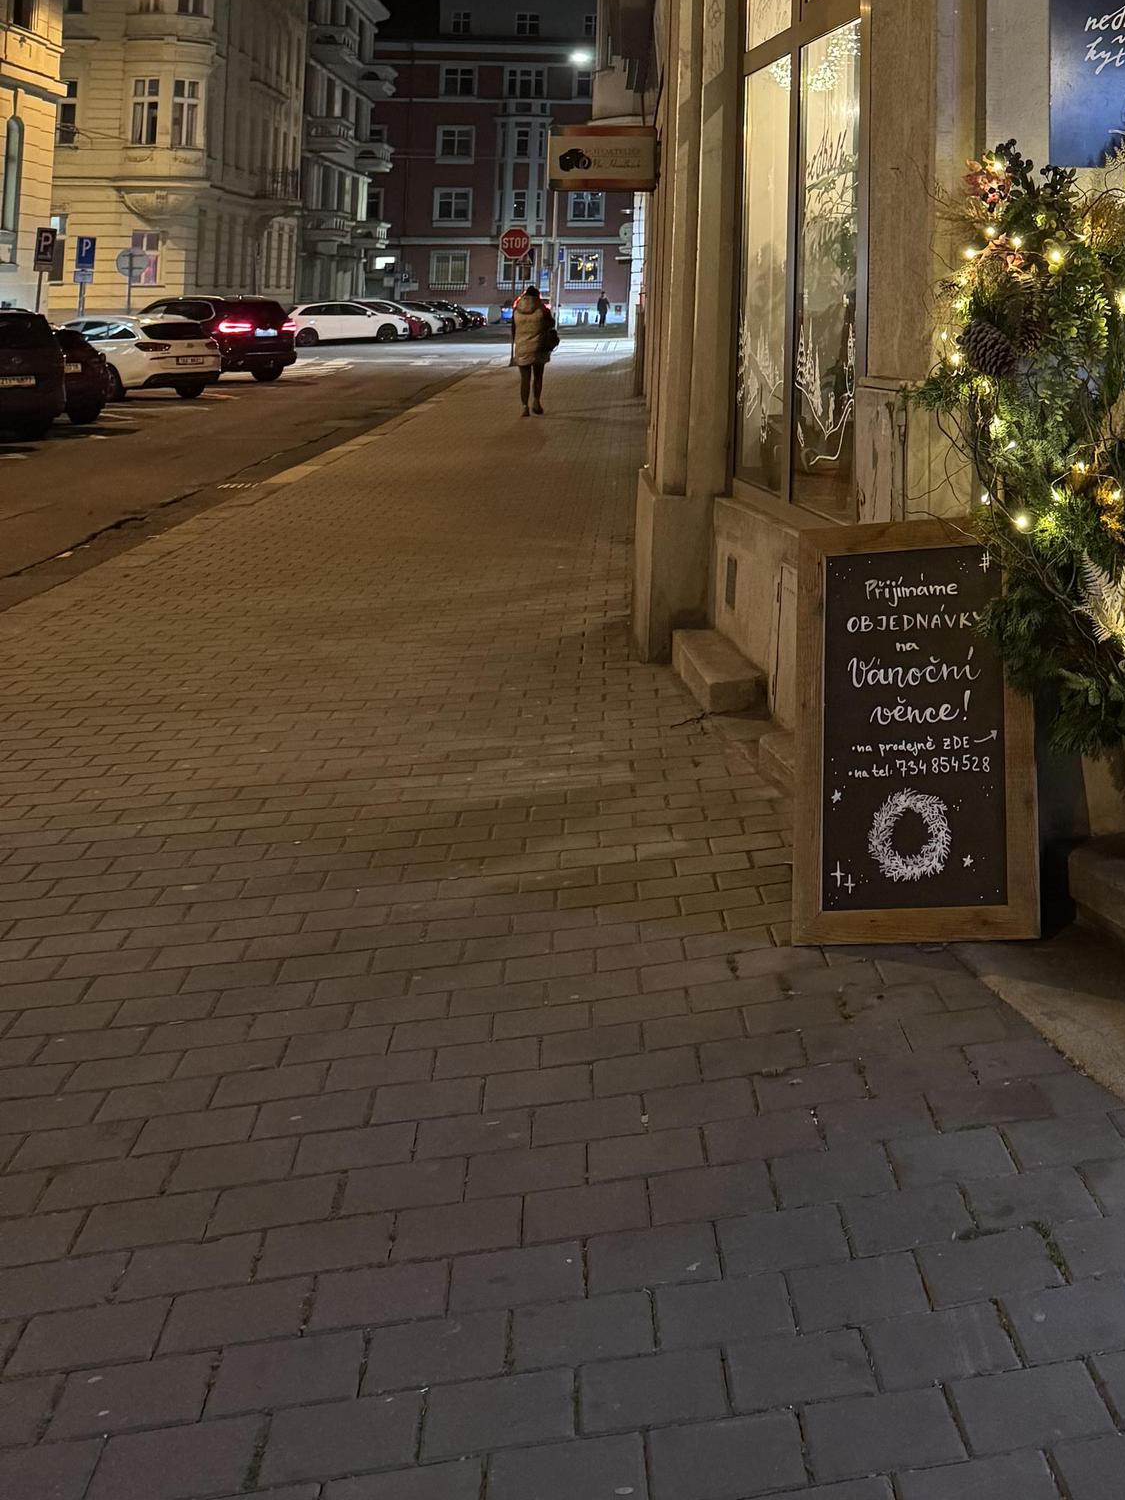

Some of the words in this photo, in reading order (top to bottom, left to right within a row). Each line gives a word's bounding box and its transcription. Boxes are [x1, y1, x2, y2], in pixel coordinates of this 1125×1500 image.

[40, 232, 53, 252] P
[81, 239, 91, 257] P
[502, 237, 528, 249] STOP
[402, 273, 409, 282] P
[864, 573, 959, 607] Přijímáme
[895, 642, 920, 652] na
[847, 646, 981, 688] Vánoční
[869, 690, 971, 726] věnce!
[879, 735, 936, 756] prodejně
[943, 735, 970, 750] ZDE
